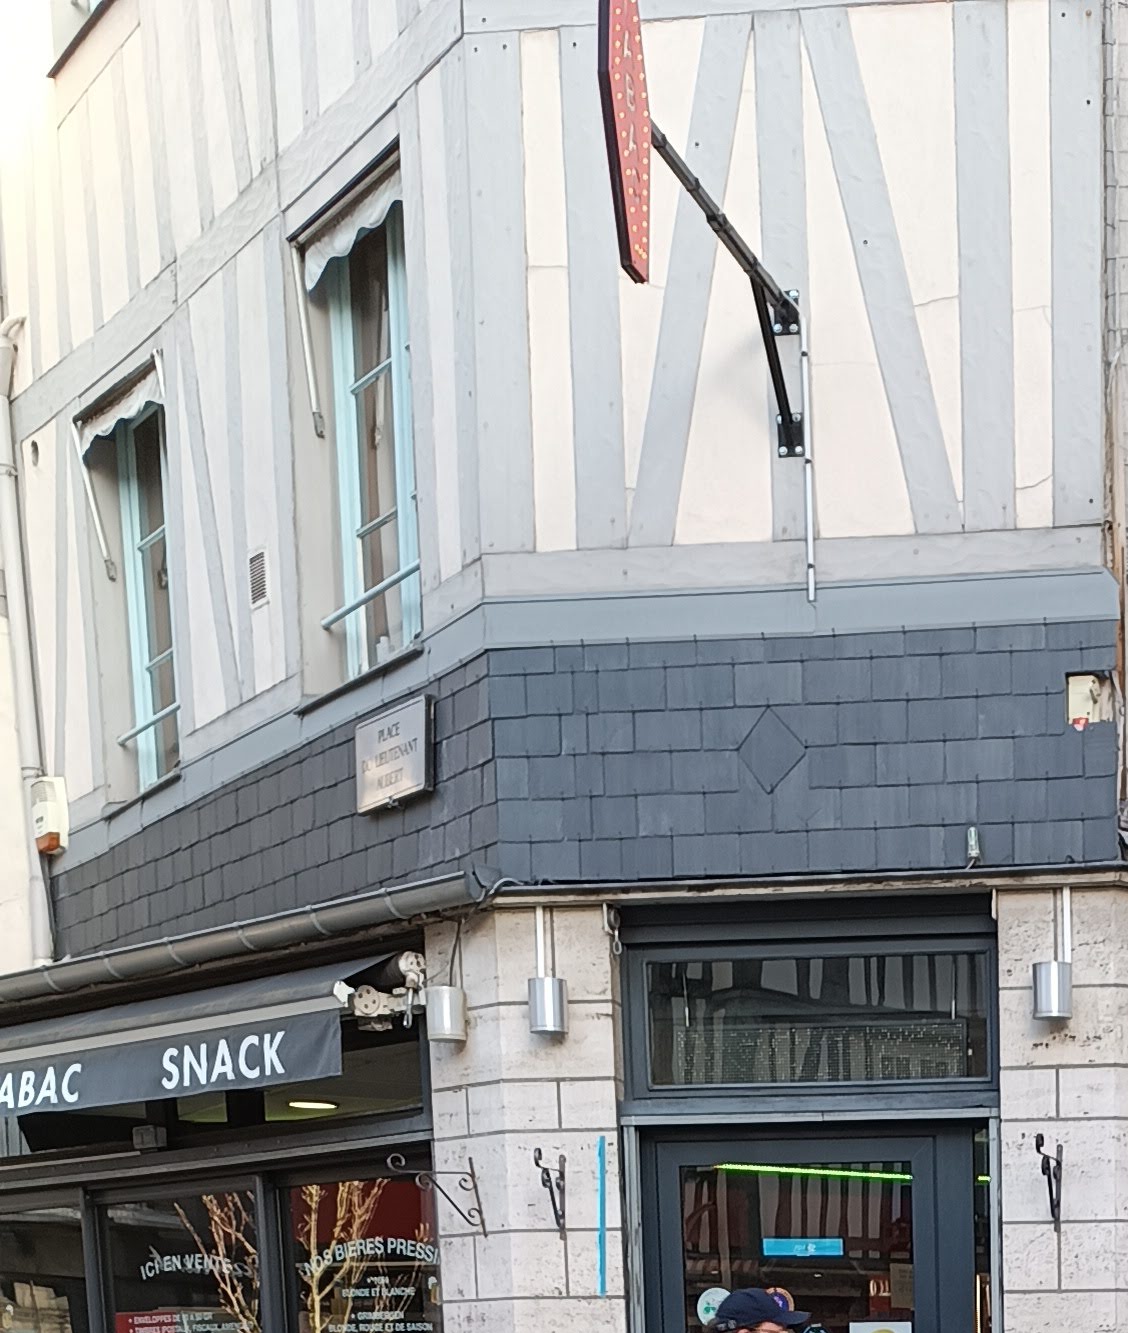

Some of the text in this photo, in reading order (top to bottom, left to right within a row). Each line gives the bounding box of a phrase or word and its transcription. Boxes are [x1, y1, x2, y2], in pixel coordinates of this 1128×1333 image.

[378, 722, 400, 744] PLACE
[162, 1031, 286, 1089] SNACK
[140, 1256, 161, 1281] ICI
[163, 1254, 182, 1272] EN
[303, 1249, 333, 1276] NOS
